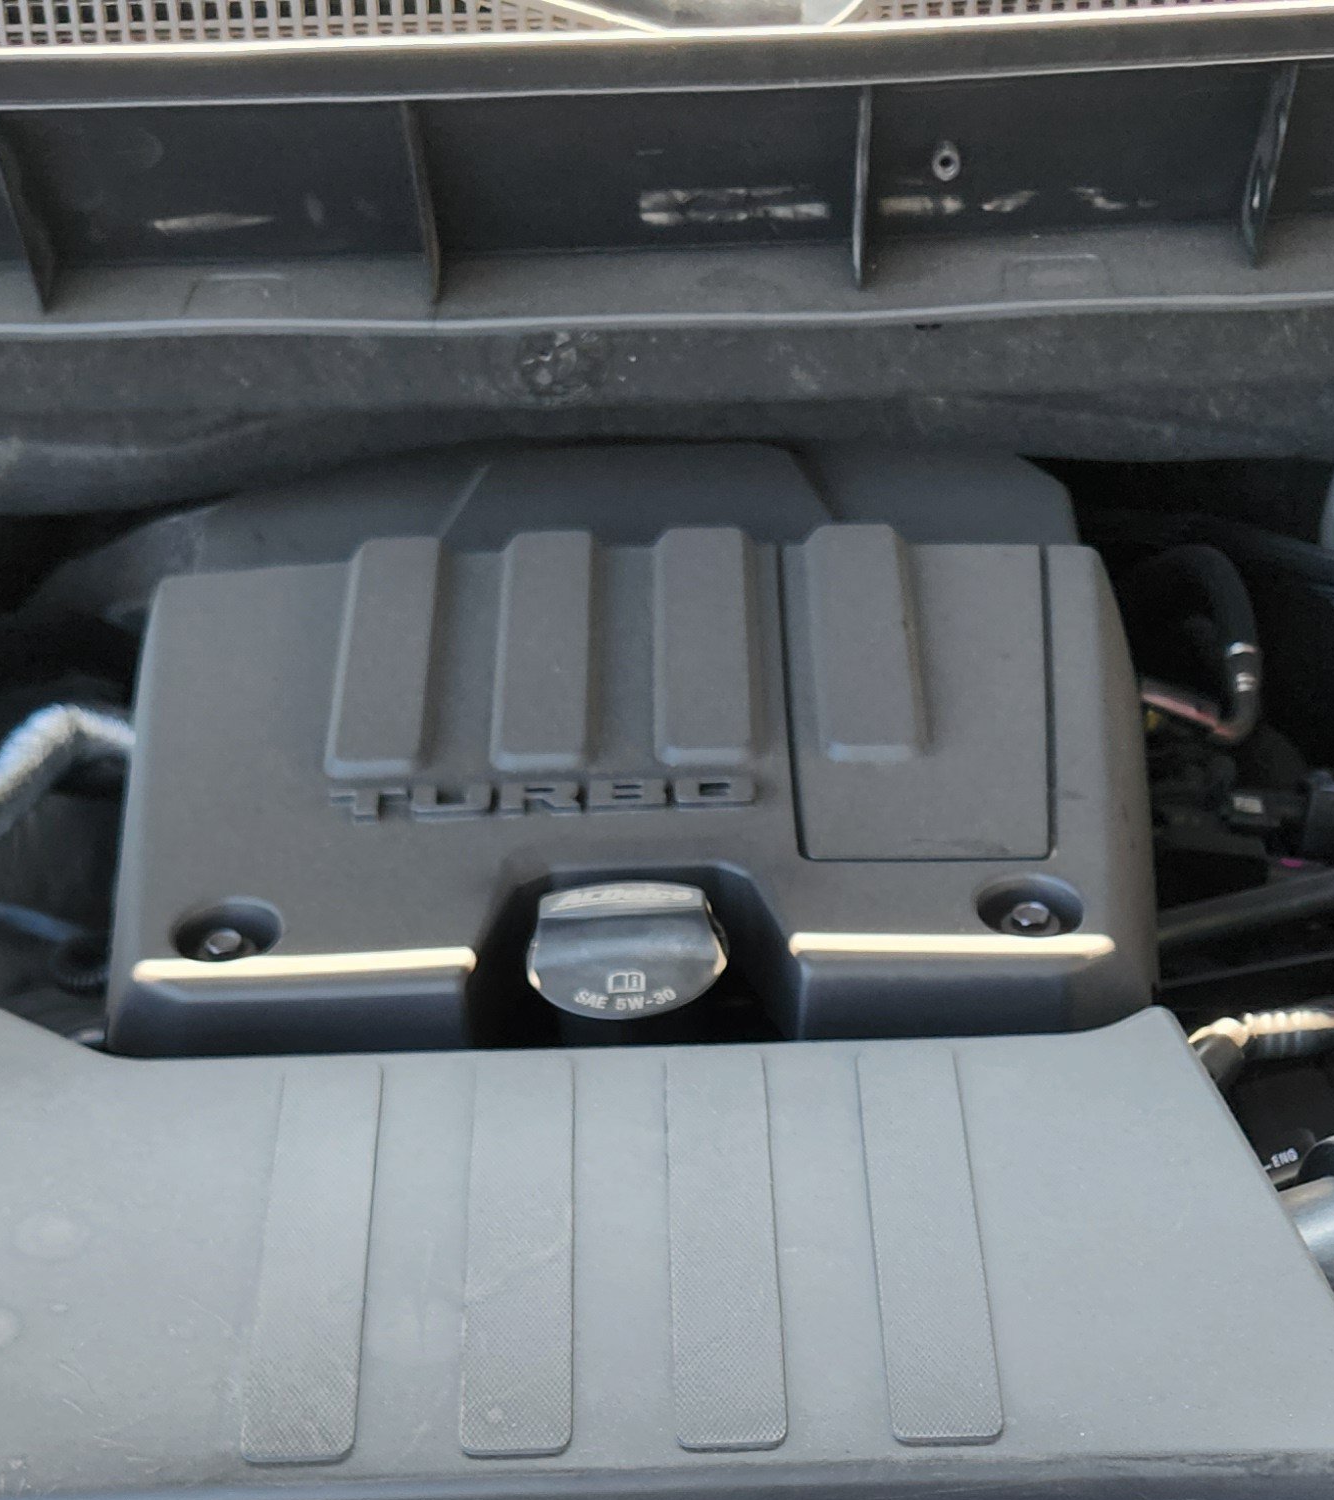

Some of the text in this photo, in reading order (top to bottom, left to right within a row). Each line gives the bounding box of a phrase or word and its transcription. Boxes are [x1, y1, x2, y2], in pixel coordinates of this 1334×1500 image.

[328, 777, 755, 825] TURBO
[573, 988, 677, 1011] SAE 5W-30
